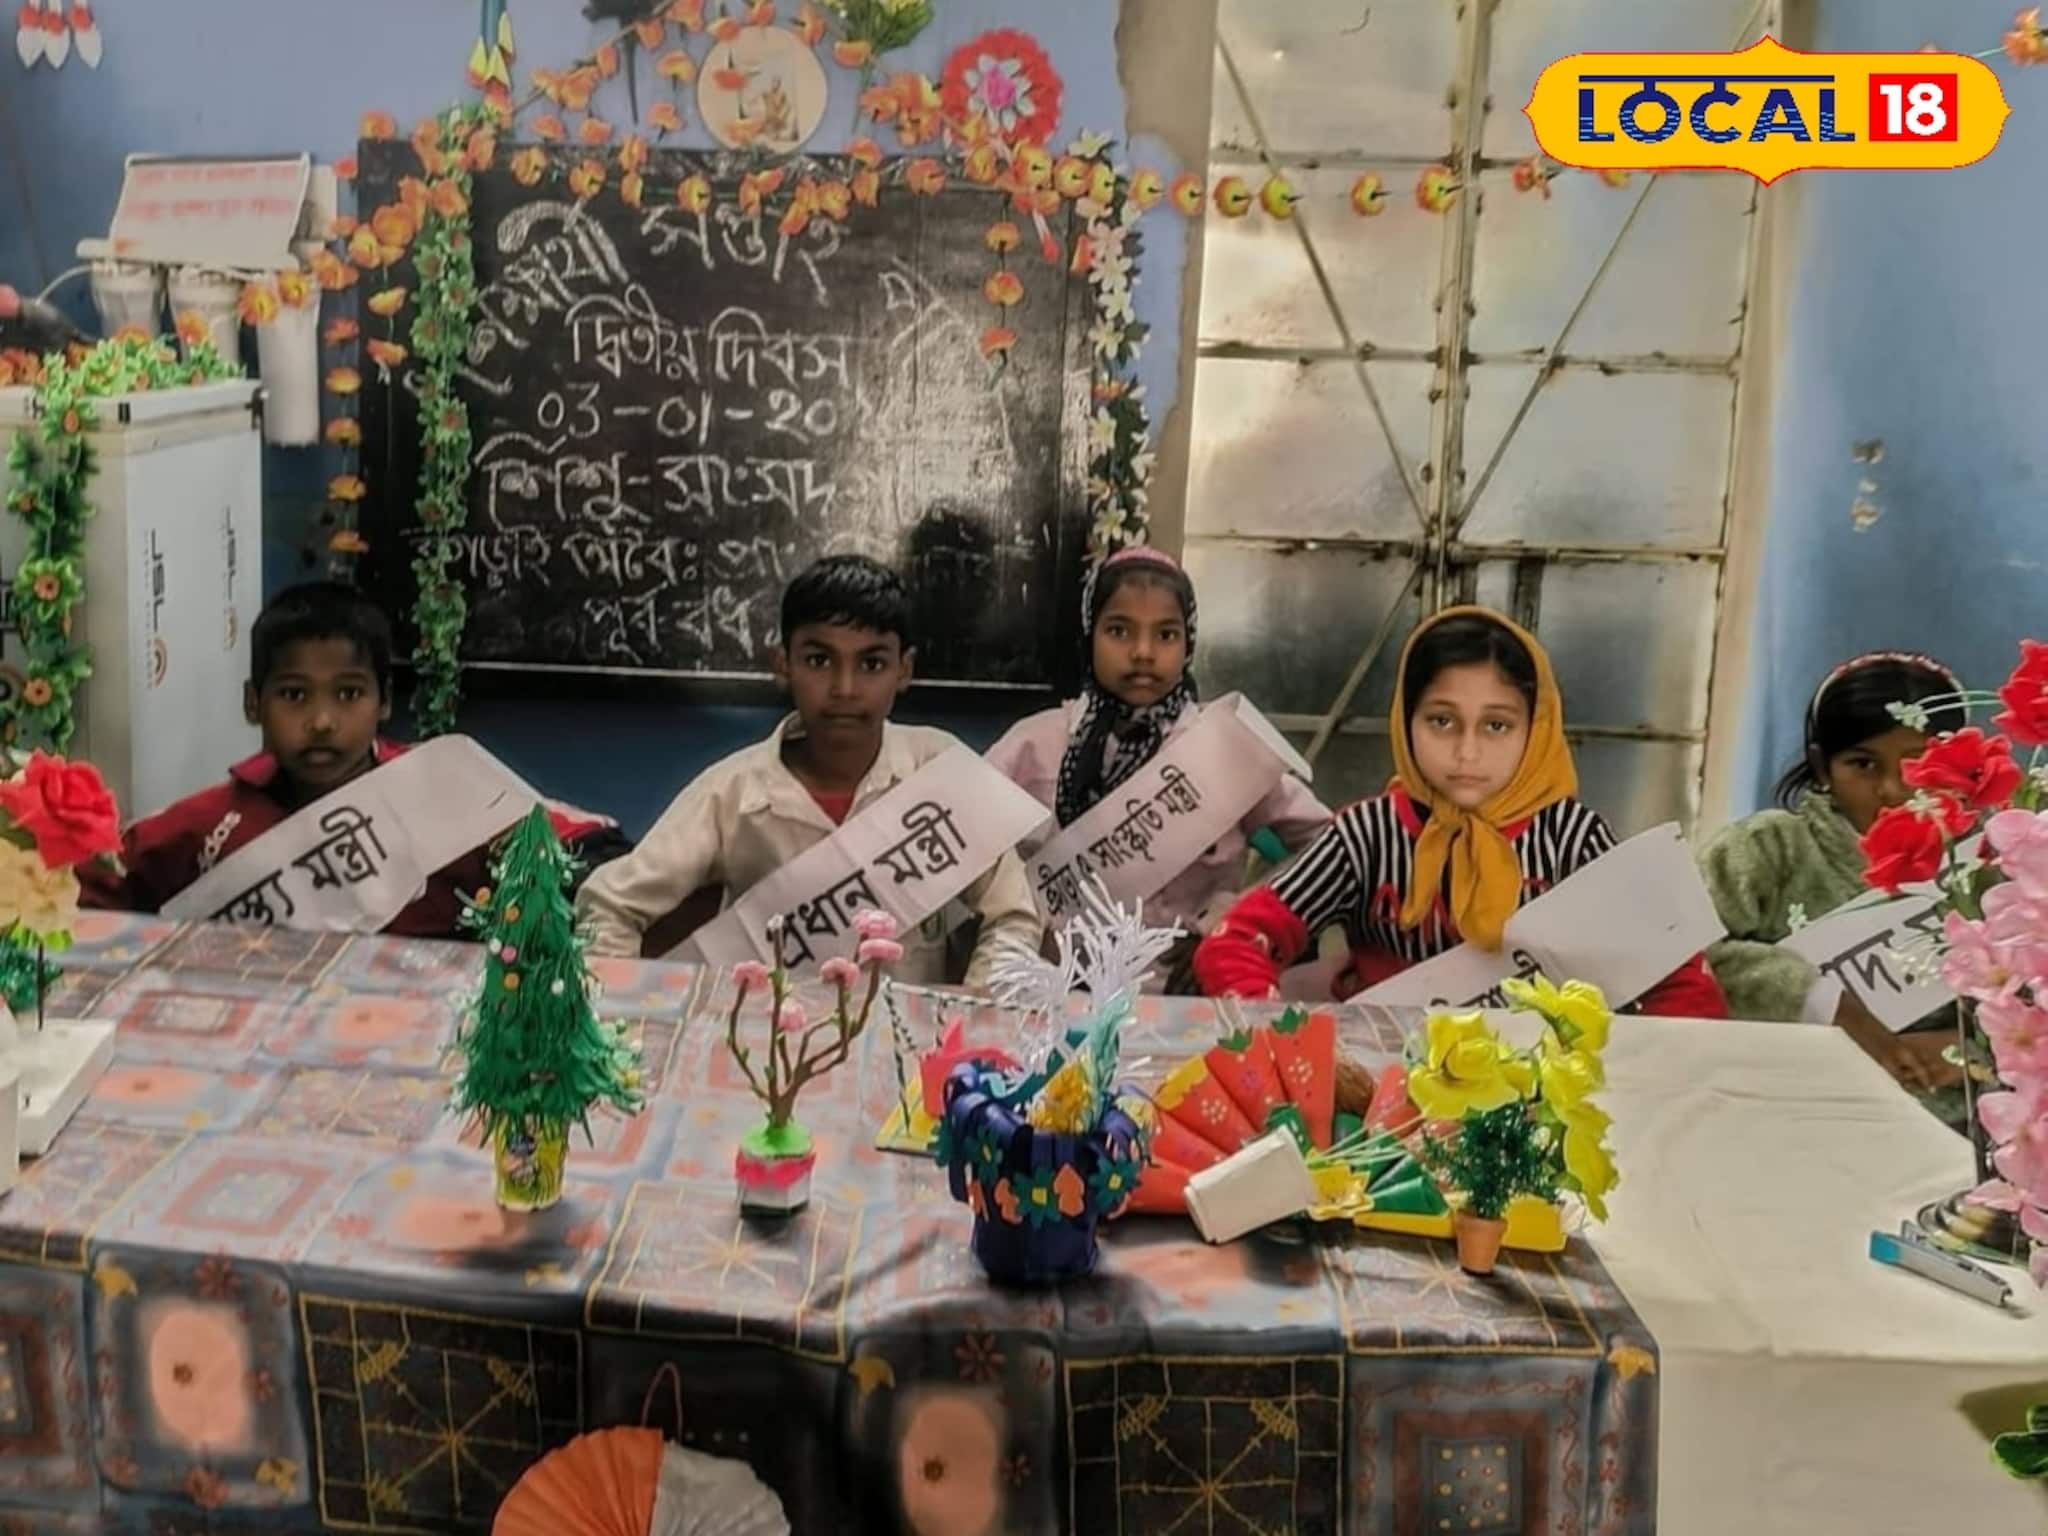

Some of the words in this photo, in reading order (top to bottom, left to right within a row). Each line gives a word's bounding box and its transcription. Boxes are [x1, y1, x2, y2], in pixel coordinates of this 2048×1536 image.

[707, 305, 862, 389] দিবস
[1154, 764, 1203, 816] মন্ত্রী
[290, 806, 388, 889] মন্ত্রী
[765, 868, 881, 968] প্রধান
[873, 801, 967, 884] মন্ত্রী
